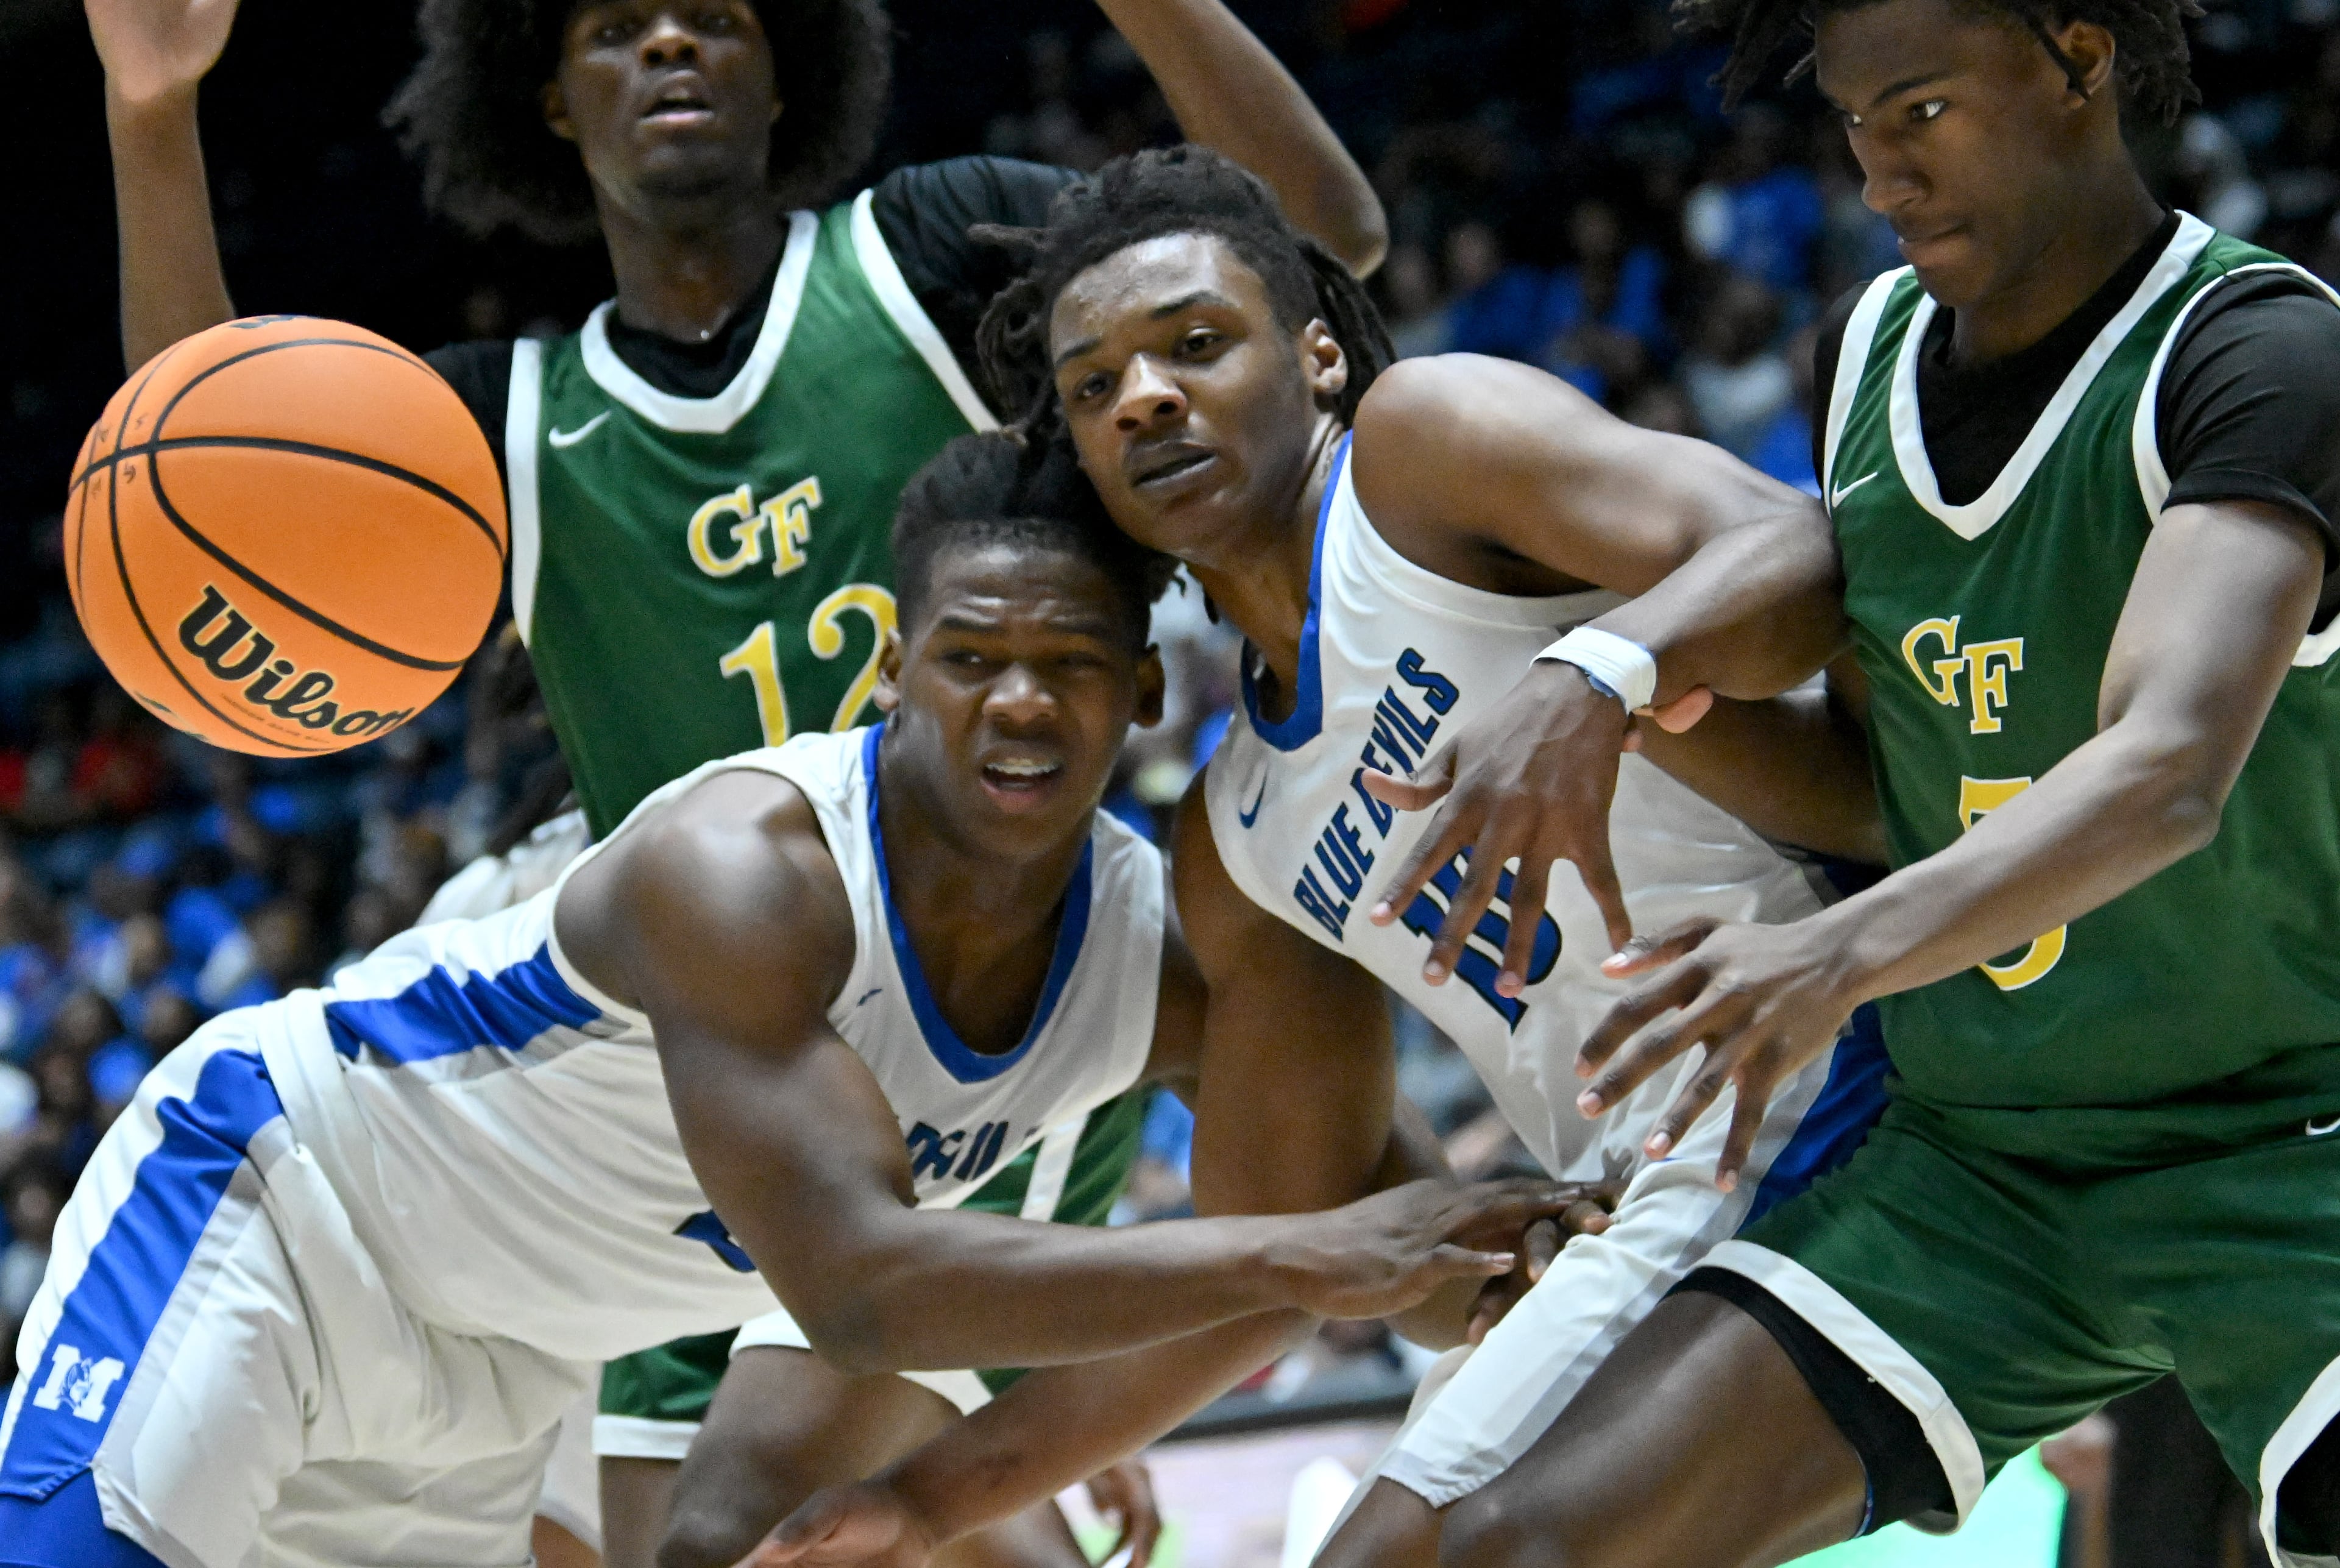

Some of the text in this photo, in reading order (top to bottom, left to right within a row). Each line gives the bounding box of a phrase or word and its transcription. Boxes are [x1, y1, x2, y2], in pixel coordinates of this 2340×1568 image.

[687, 475, 823, 576] GF
[179, 583, 416, 736] Wilson
[720, 583, 898, 747] 12
[1901, 615, 2024, 734] GF
[1293, 801, 1375, 942] BLUE
